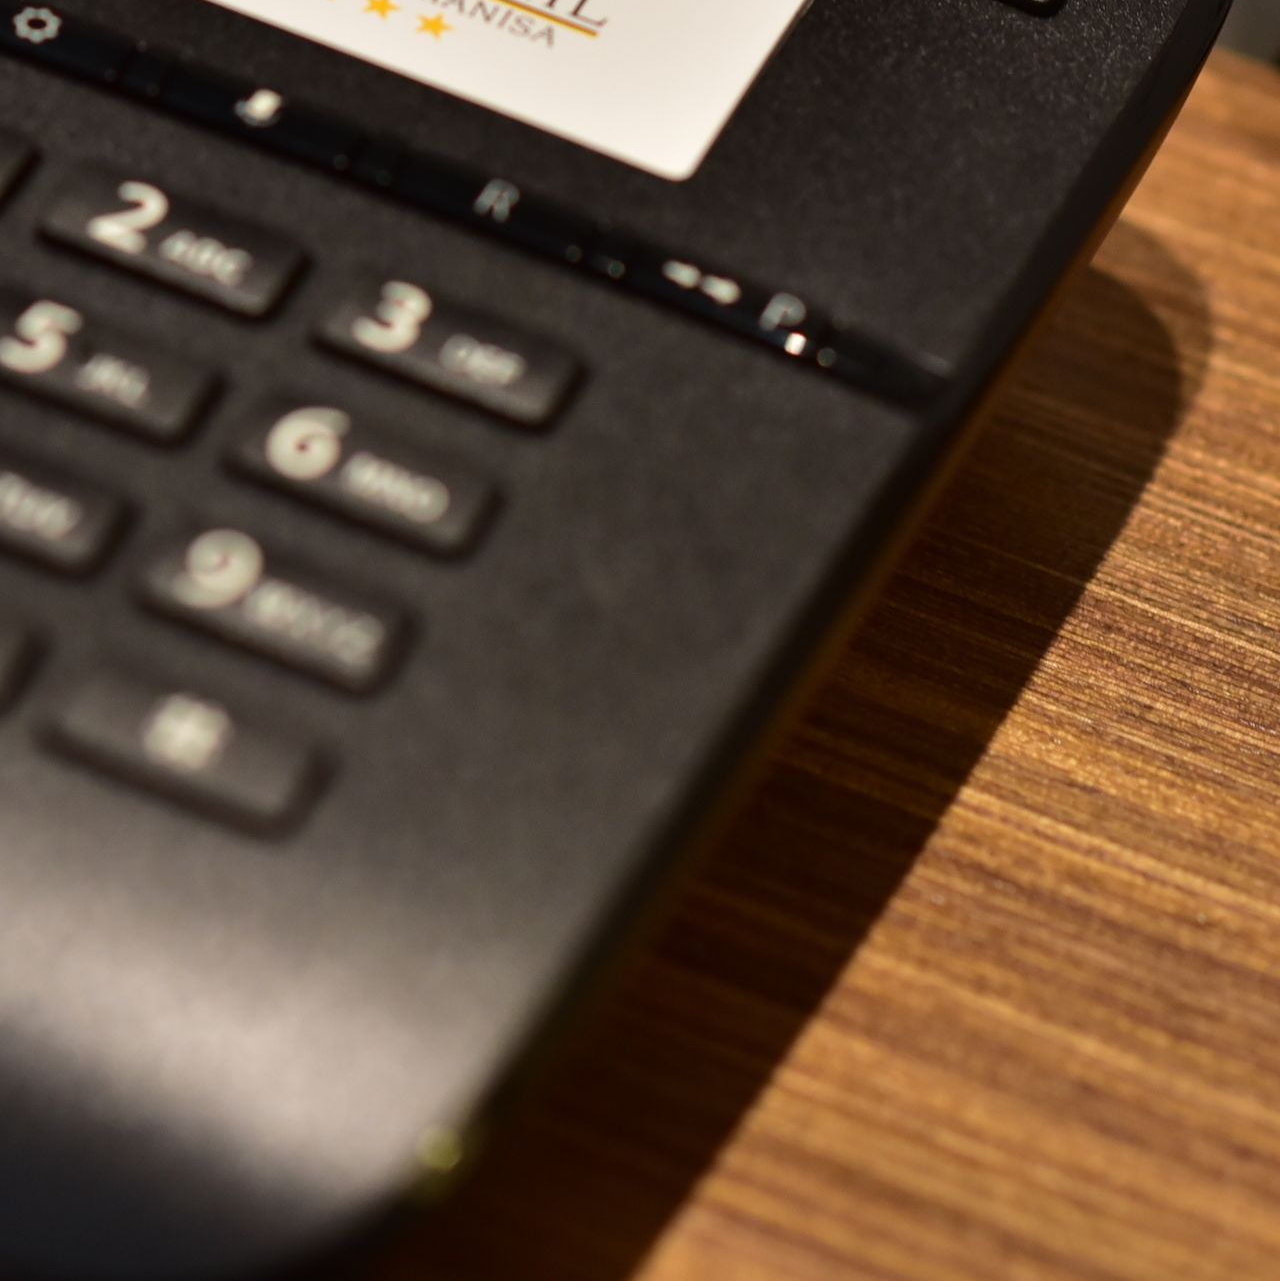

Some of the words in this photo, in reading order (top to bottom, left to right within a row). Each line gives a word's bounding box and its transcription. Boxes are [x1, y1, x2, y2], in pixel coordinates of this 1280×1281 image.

[86, 180, 170, 254] 2
[351, 280, 433, 354] 3
[264, 406, 352, 482] 6
[170, 527, 266, 610] 9
